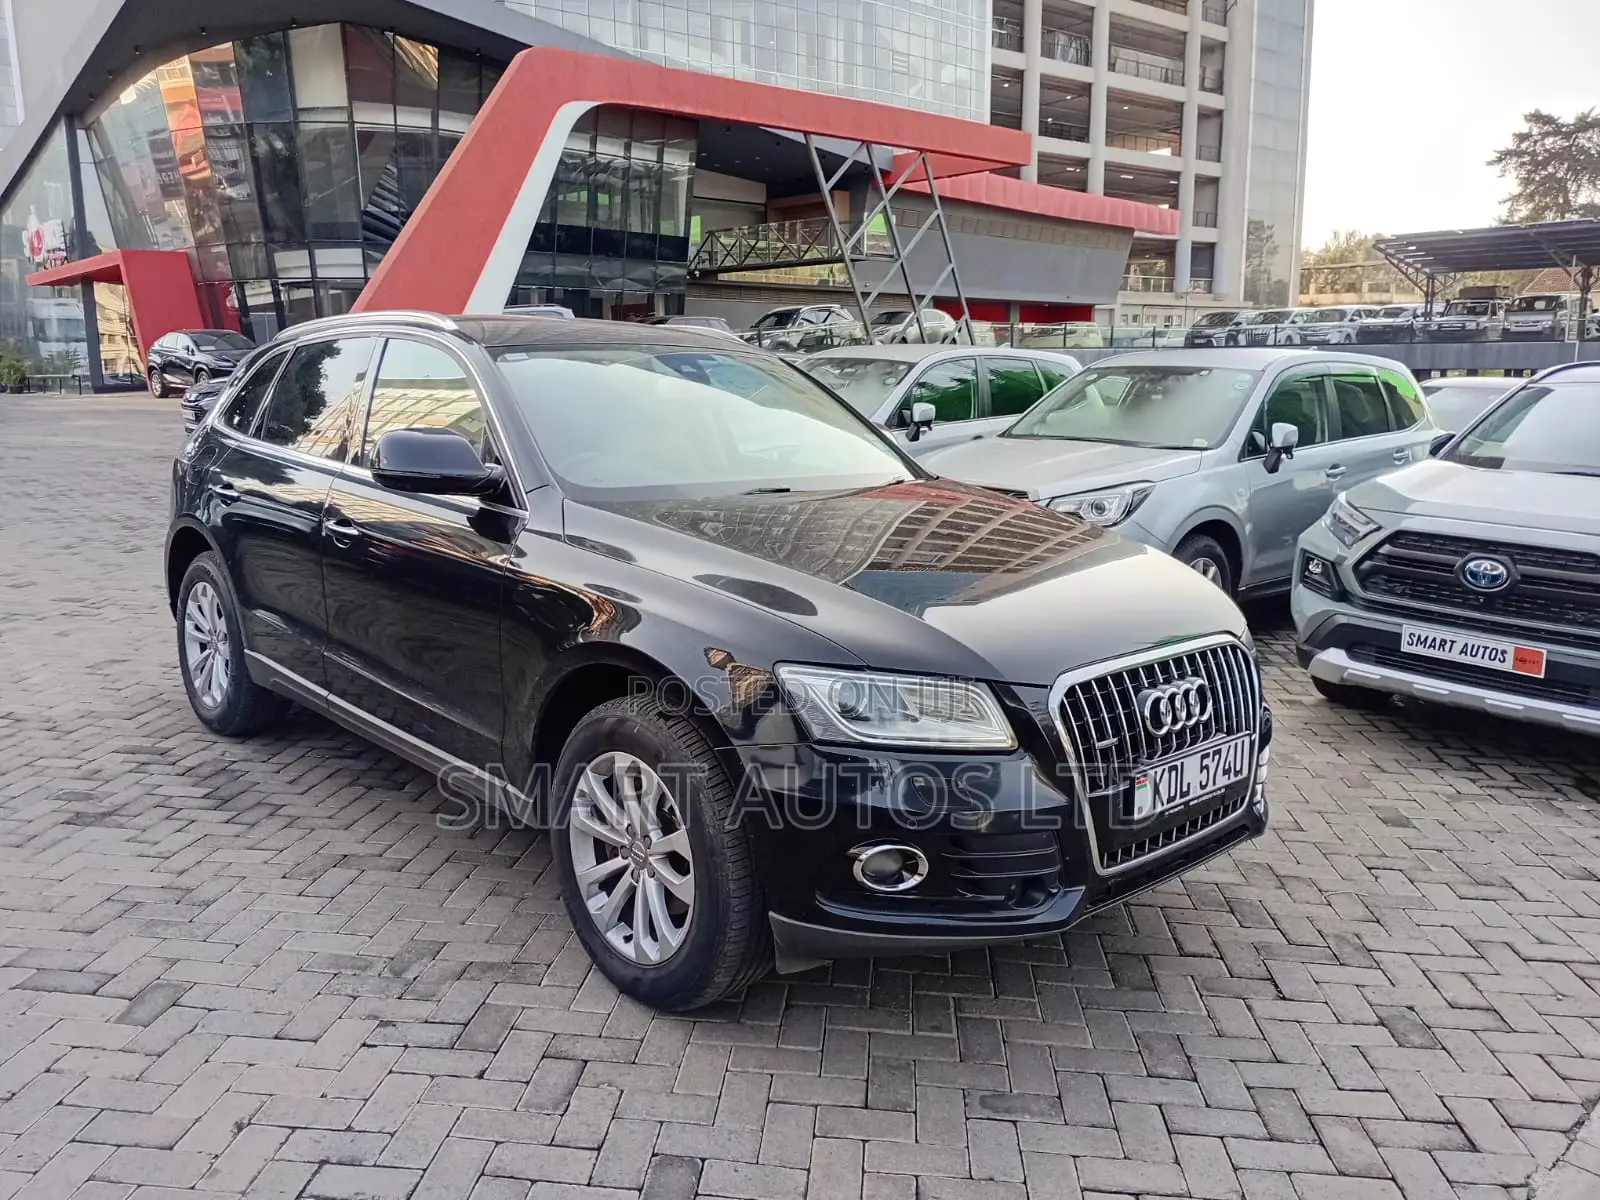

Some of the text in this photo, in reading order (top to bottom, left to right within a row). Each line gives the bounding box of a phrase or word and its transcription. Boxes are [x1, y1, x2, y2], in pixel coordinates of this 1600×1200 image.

[1406, 632, 1457, 653] SMART
[1458, 642, 1509, 664] AUTOS
[1152, 761, 1192, 810] KDL
[1199, 739, 1246, 791] 574U
